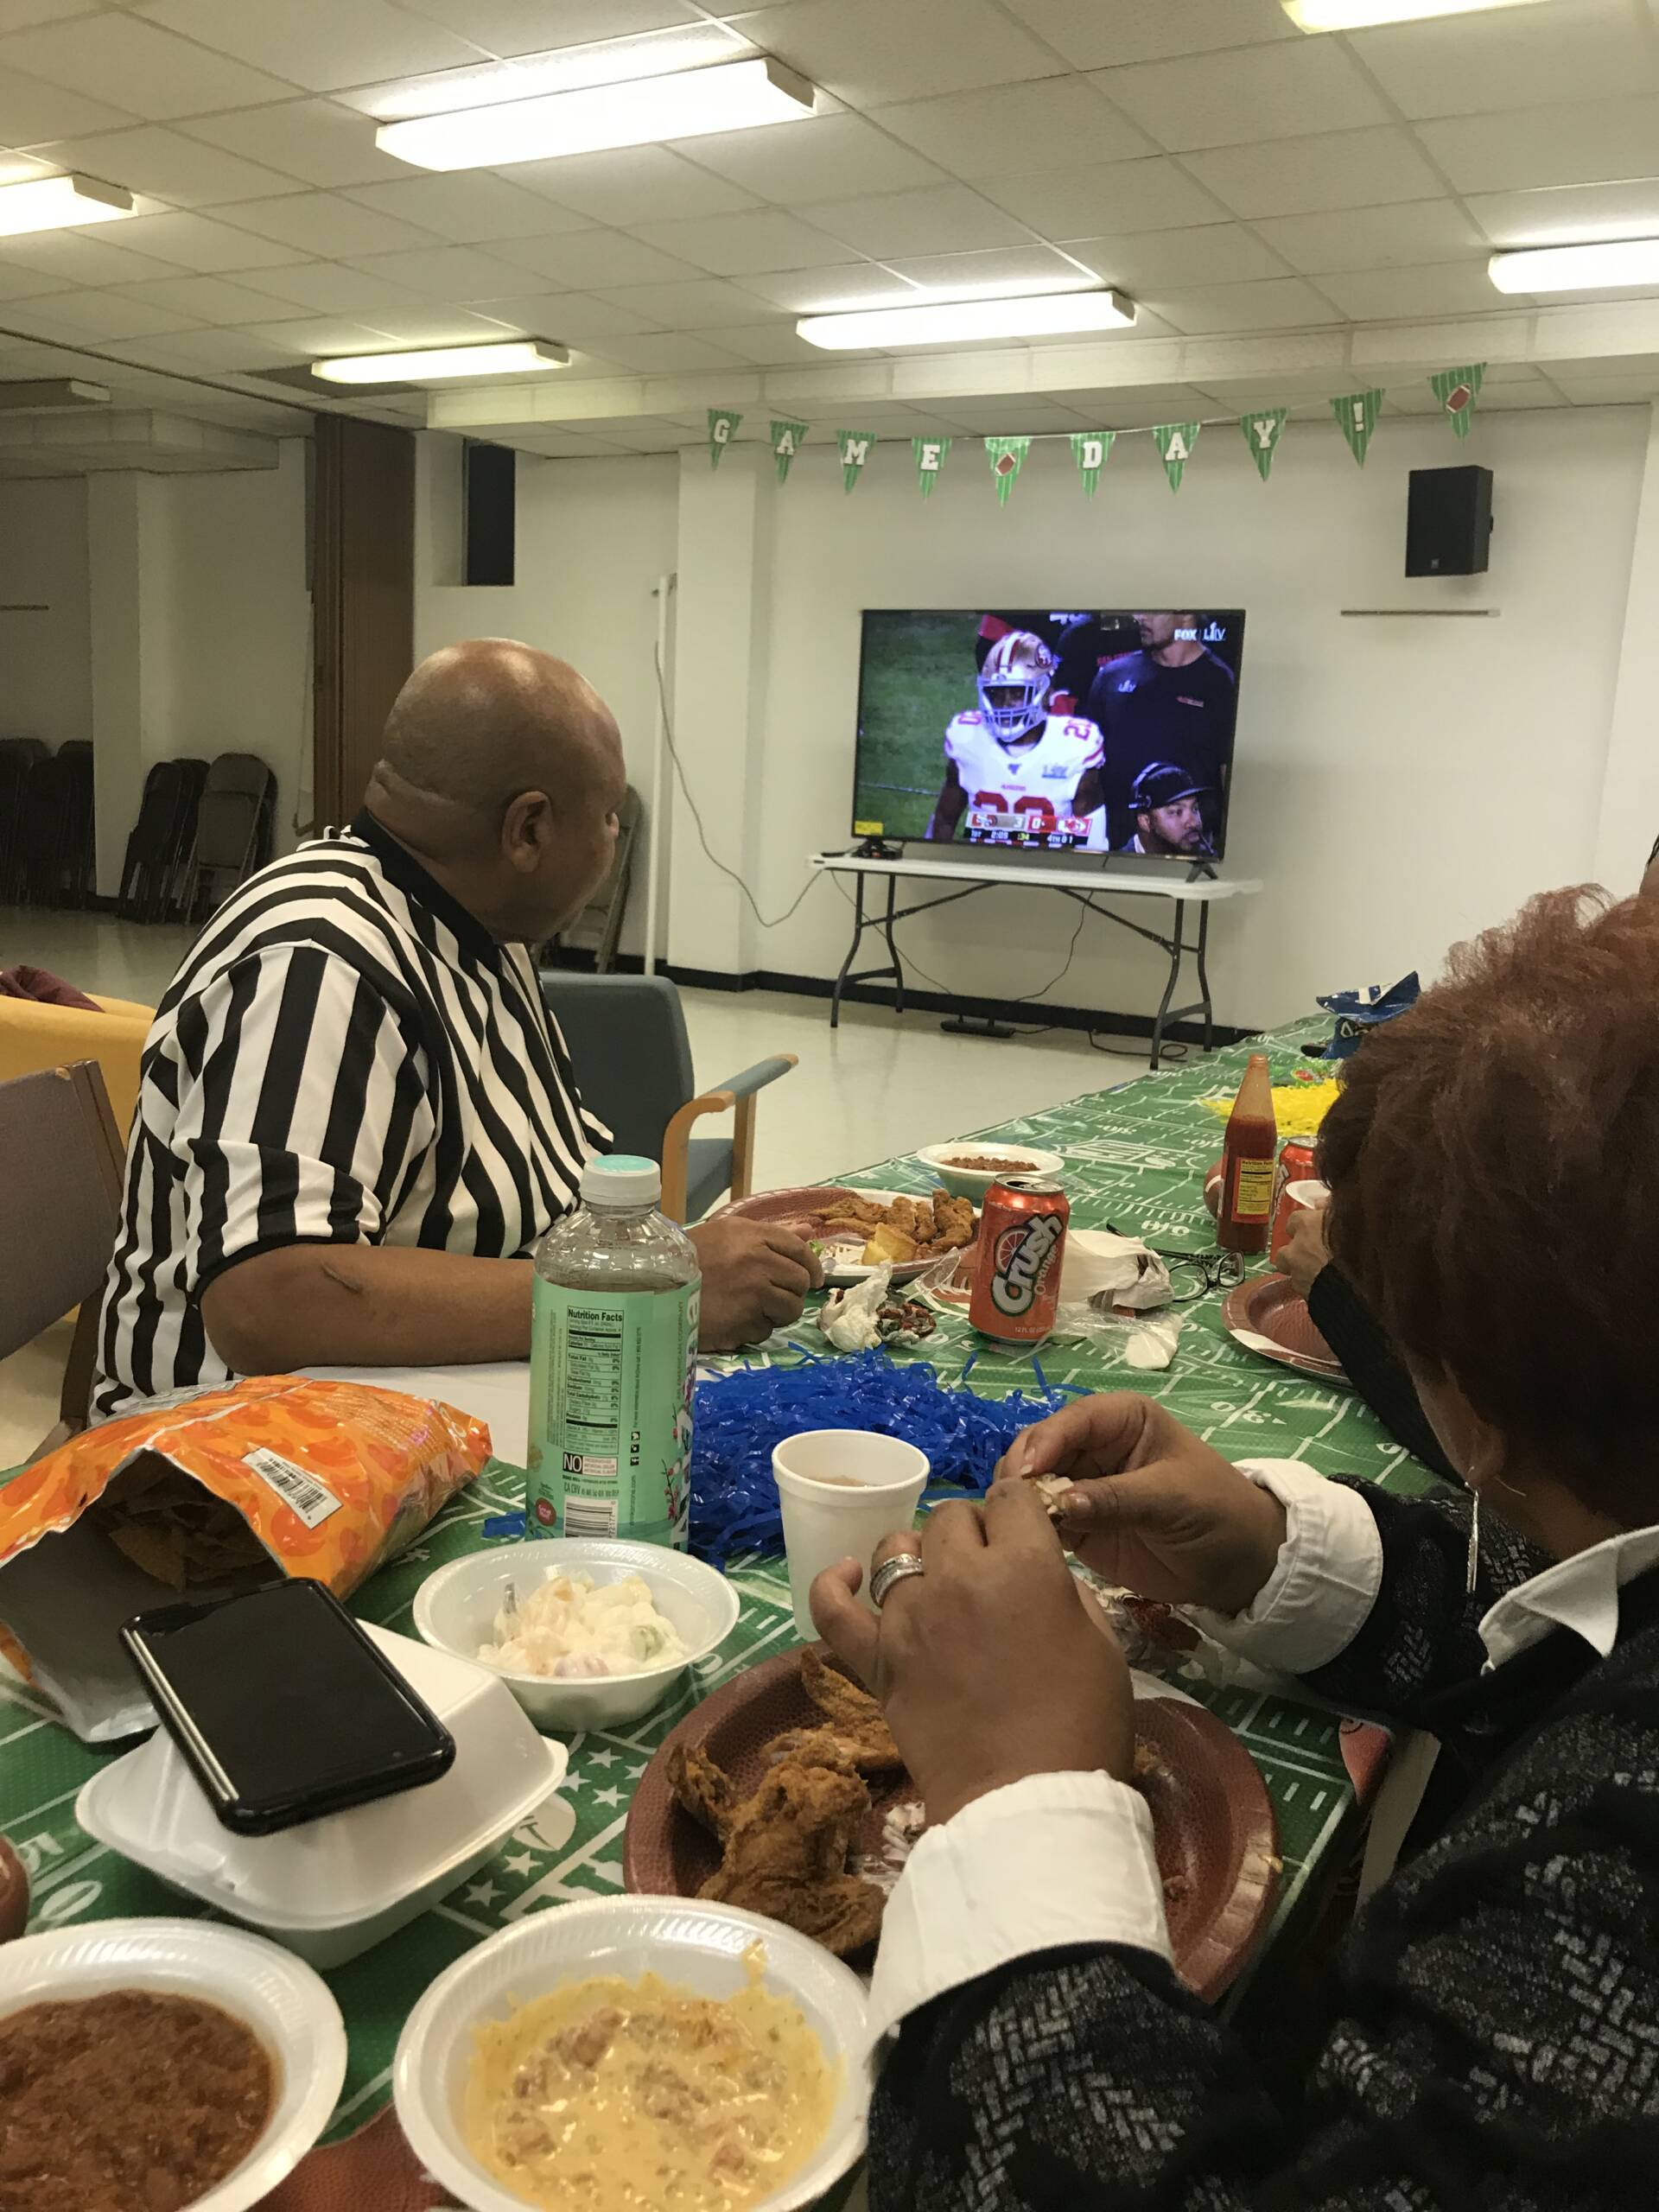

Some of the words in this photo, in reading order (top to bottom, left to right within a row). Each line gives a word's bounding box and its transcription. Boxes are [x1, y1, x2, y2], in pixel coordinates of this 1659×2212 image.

[1174, 628, 1198, 641] FOX
[1013, 817, 1022, 829] 3
[991, 1212, 1064, 1315] Crush
[1033, 1245, 1059, 1296] Orange
[568, 1308, 600, 1320] Nutrition
[601, 1312, 623, 1322] Facts
[563, 1453, 582, 1472] NO
